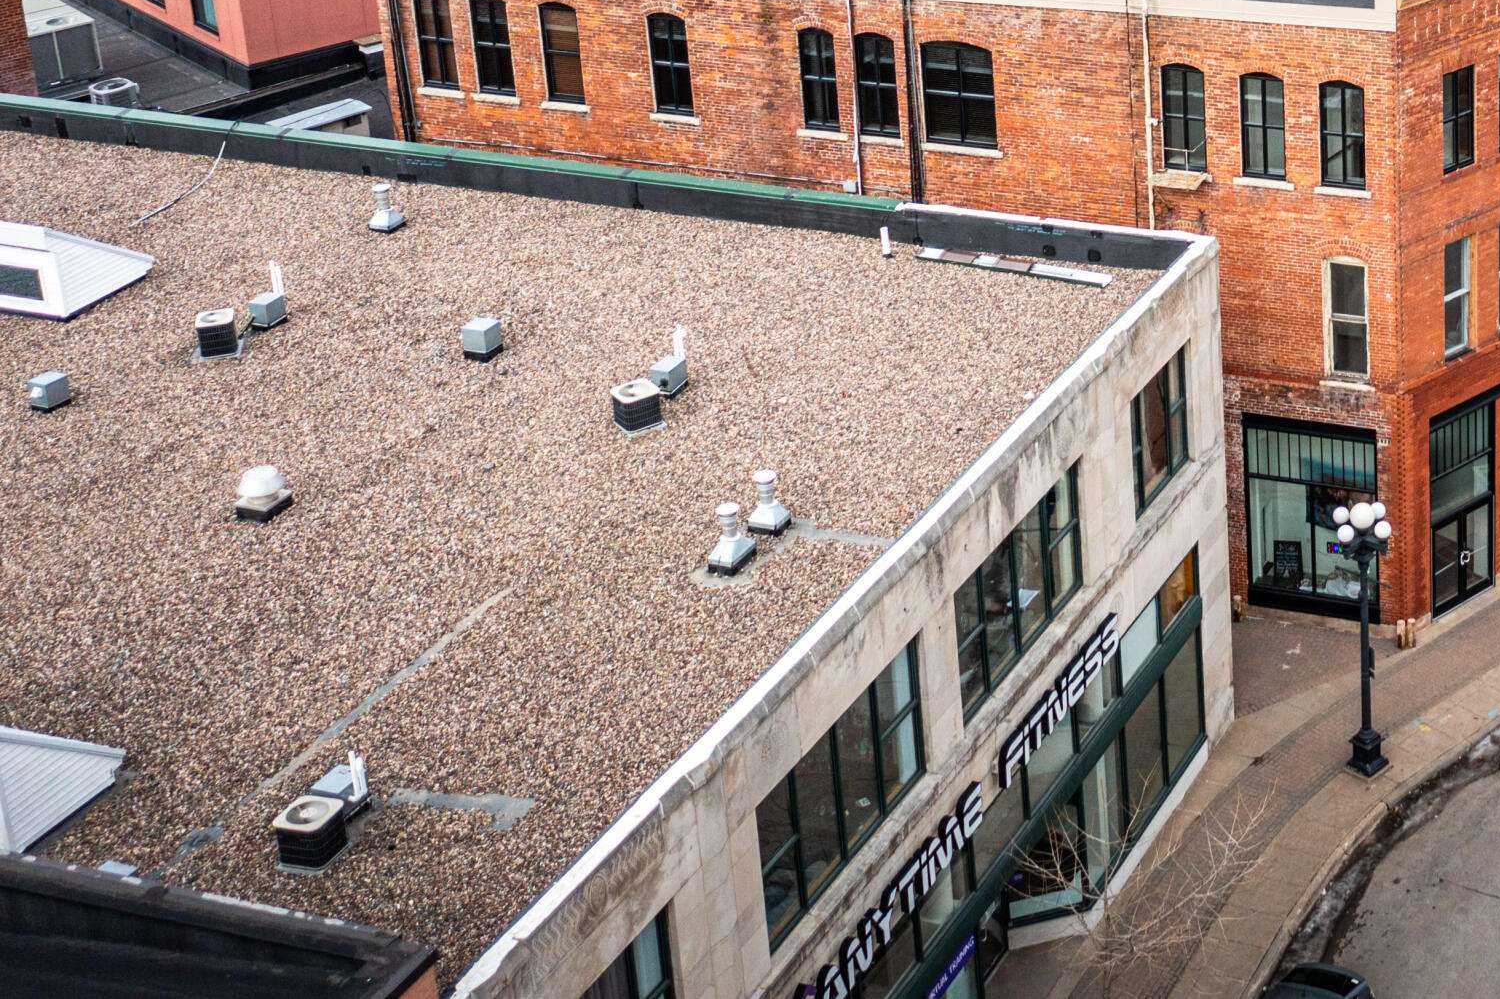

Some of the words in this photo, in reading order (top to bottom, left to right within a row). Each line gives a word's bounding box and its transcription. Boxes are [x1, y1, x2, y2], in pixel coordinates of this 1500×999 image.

[818, 782, 983, 999] ANYTIME
[1002, 618, 1119, 789] FITNESS
[949, 935, 975, 974] TRAINING
